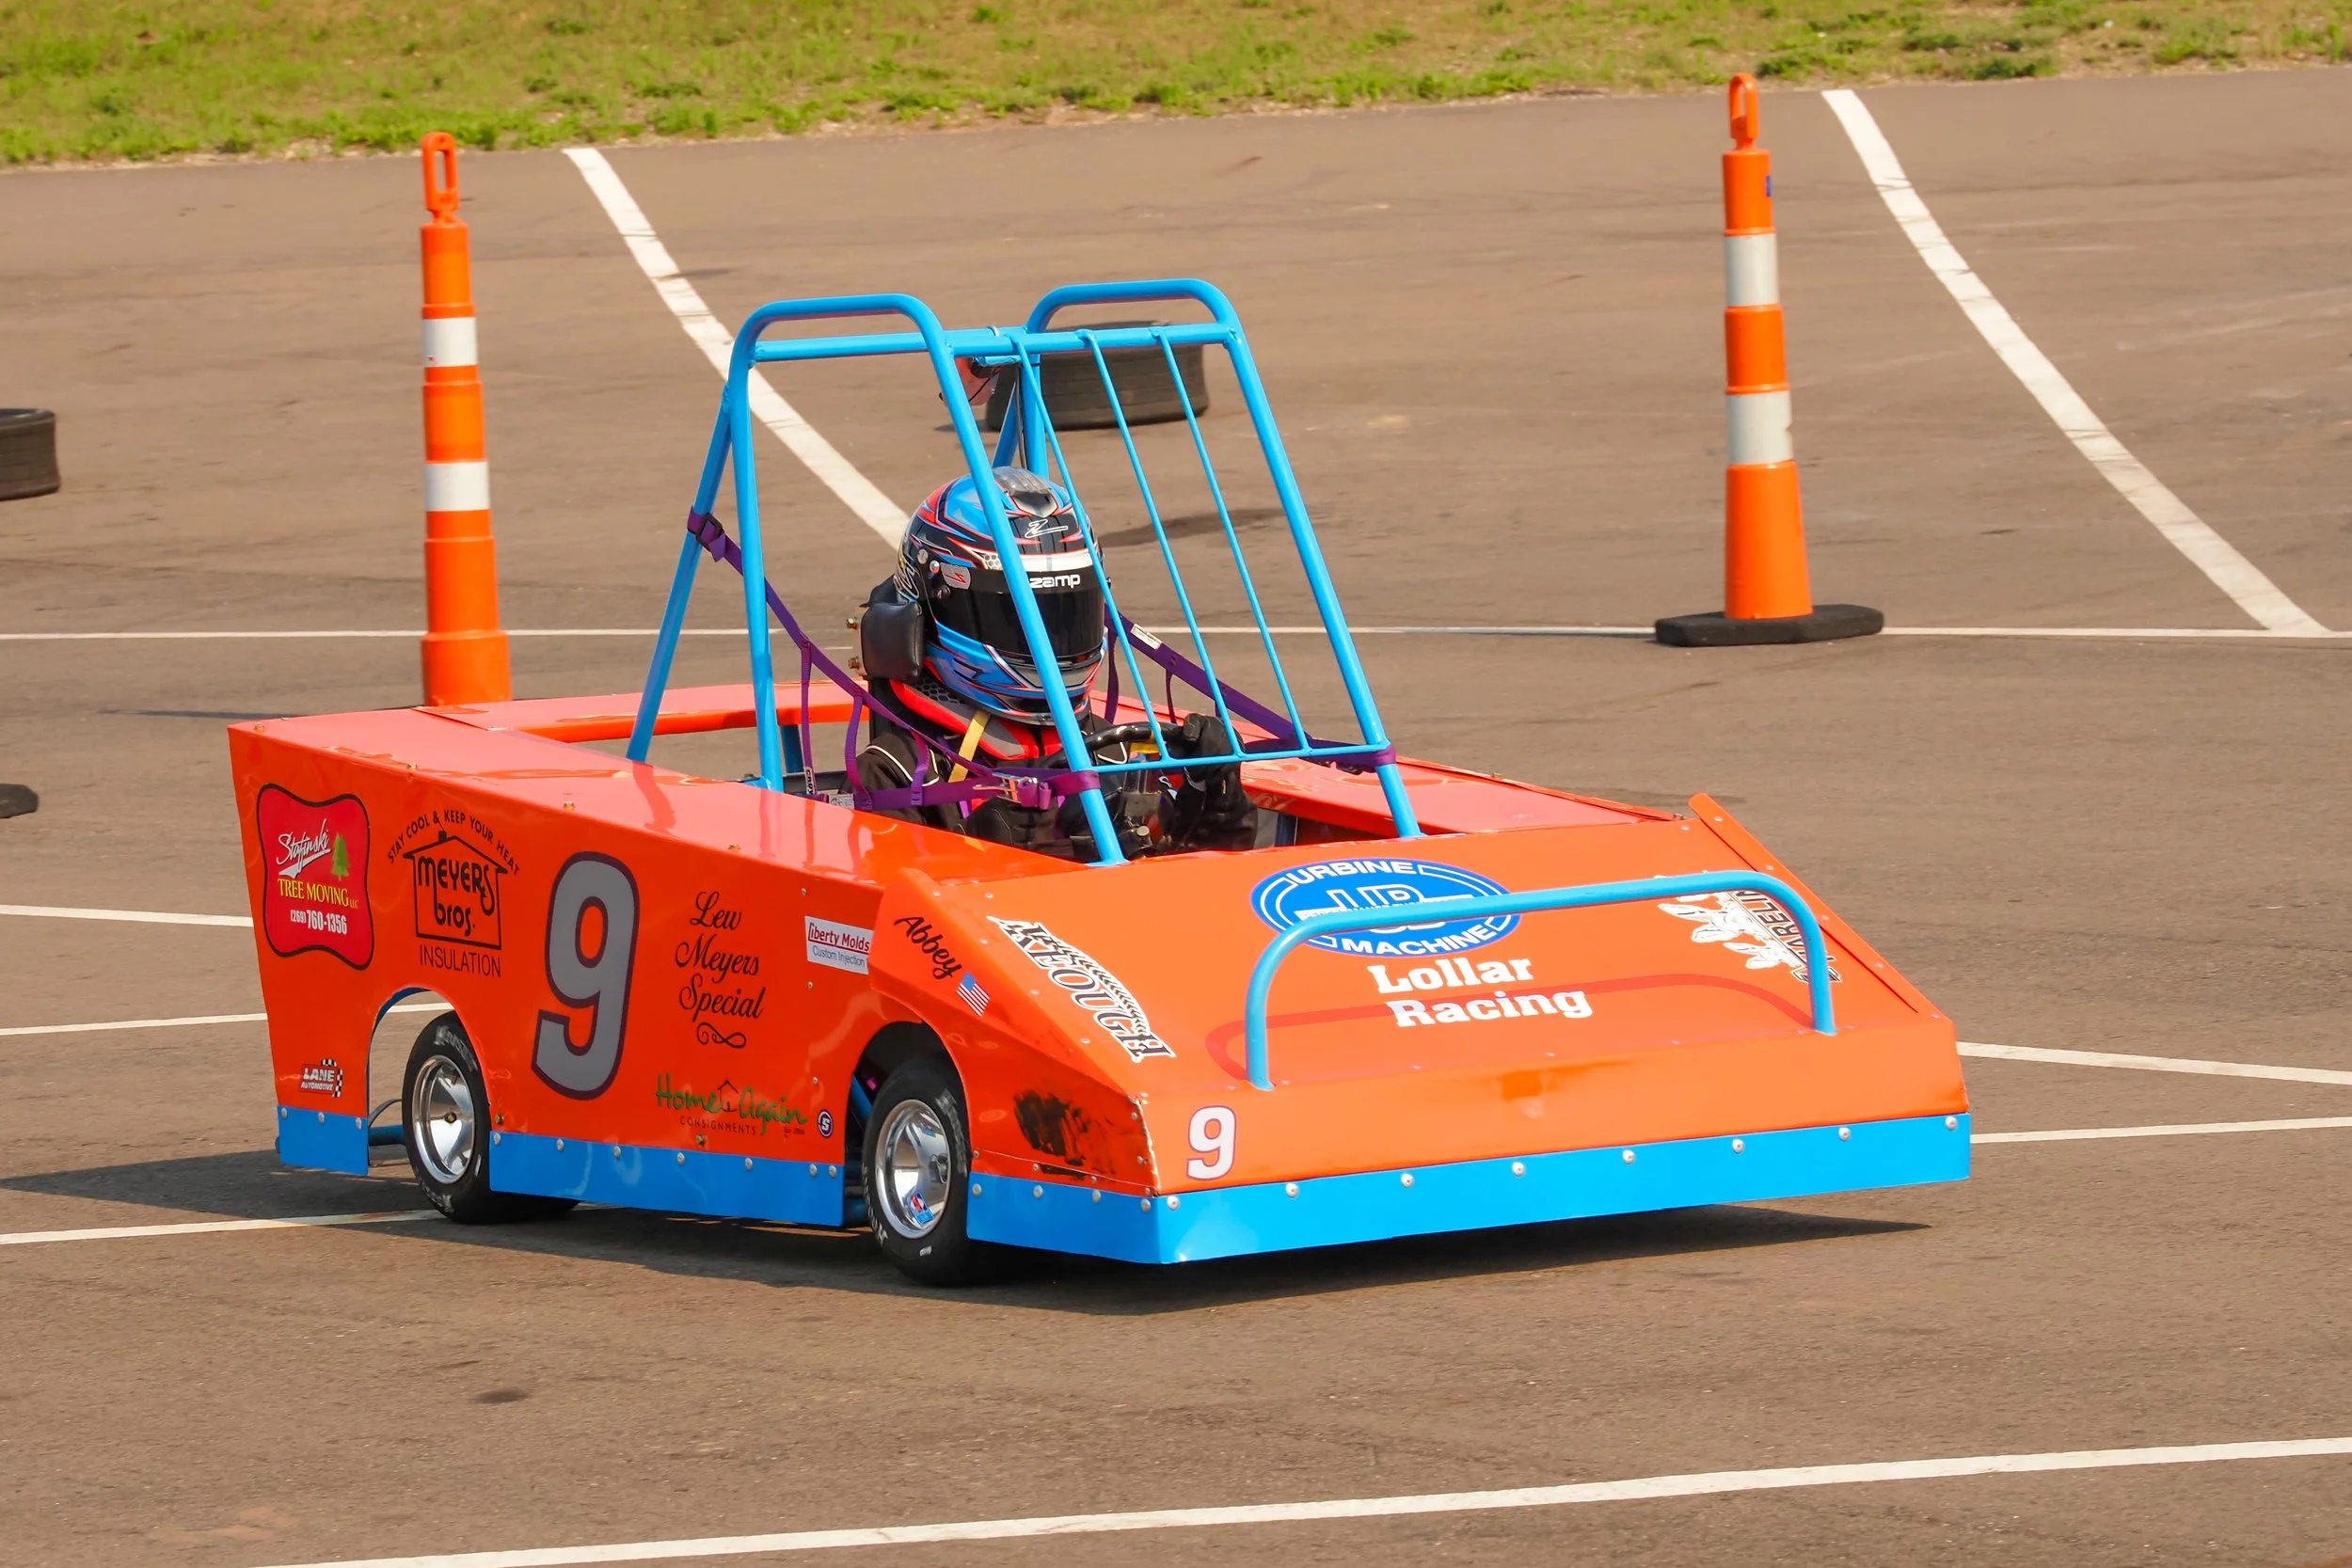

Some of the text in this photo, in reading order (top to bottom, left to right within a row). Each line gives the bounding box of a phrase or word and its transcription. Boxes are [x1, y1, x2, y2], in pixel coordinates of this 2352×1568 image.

[1029, 574, 1081, 589] zamp
[388, 809, 519, 876] STAY COOL & KEEP YOUR HEAT
[278, 878, 358, 910] TREE MOVING LLC
[690, 891, 742, 930] Lew
[307, 909, 347, 935] 760-1356
[1341, 923, 1498, 956] MACHINE
[420, 944, 501, 978] INSULATION
[675, 933, 759, 984] Meyers
[813, 945, 866, 967] Custom Injection
[842, 933, 870, 952] Molds
[893, 916, 962, 980] Abbey
[531, 850, 641, 1101] 9
[997, 922, 1174, 1059] KEOUGH
[1367, 957, 1534, 994] Lollar
[678, 973, 767, 1022] Special
[1385, 990, 1594, 1028] Racing
[301, 1081, 334, 1091] AUTOMOTIVE
[303, 1068, 335, 1082] LANE
[656, 1071, 807, 1136] Home Again
[680, 1116, 756, 1135] CONSIGNMENTS
[1185, 1104, 1236, 1180] 9
